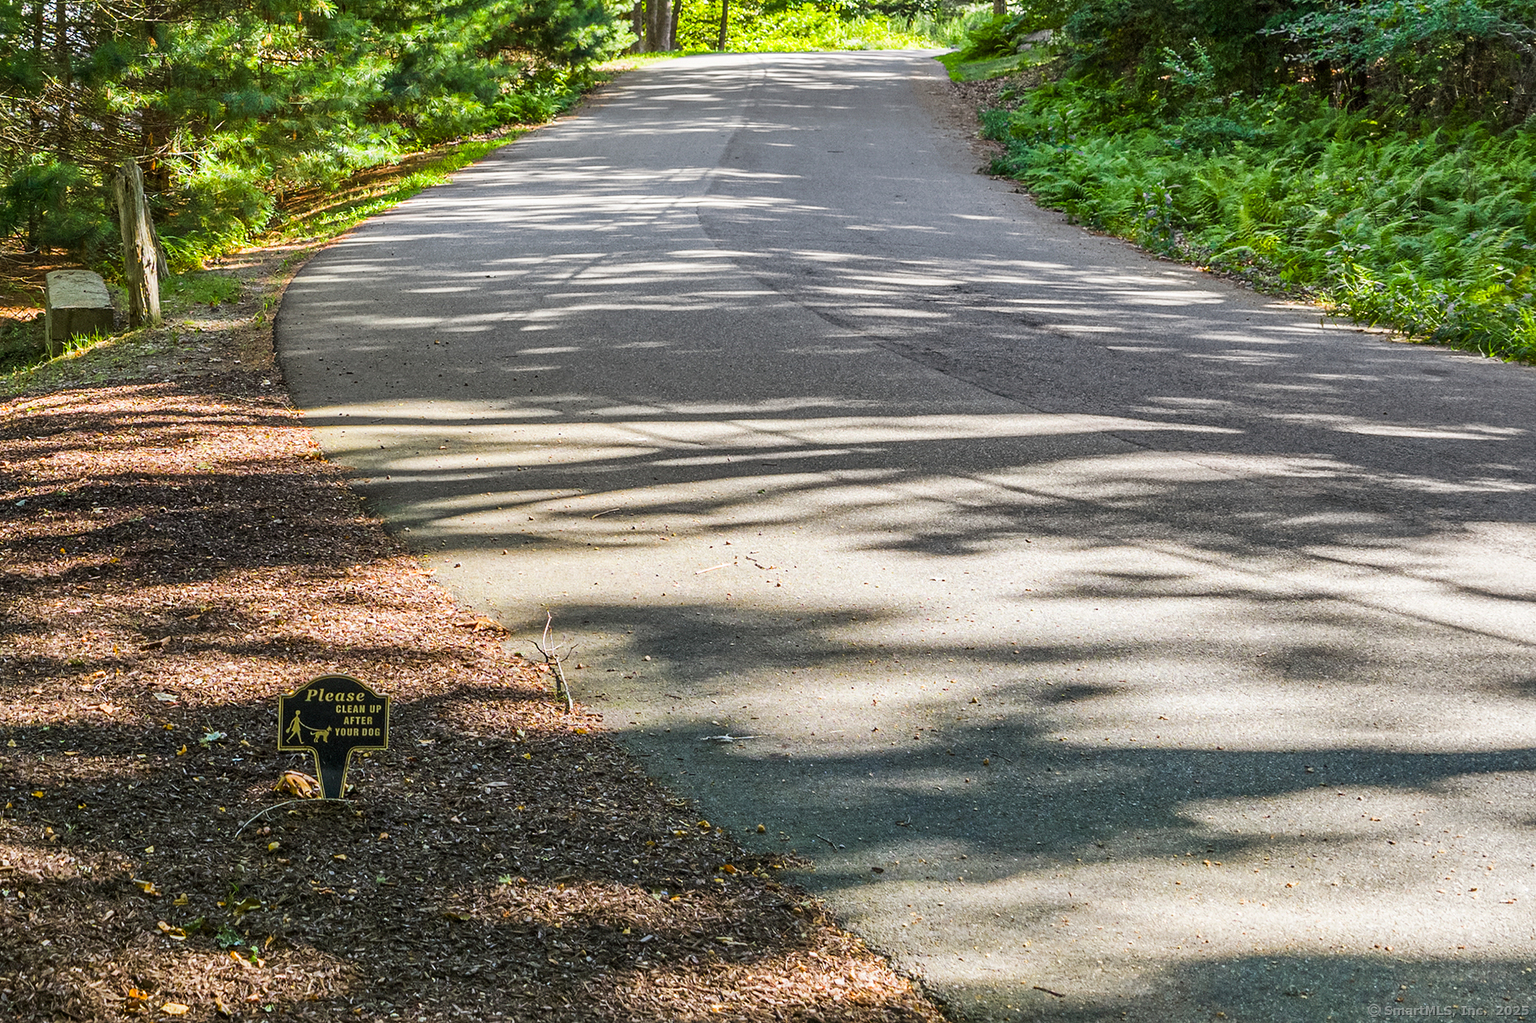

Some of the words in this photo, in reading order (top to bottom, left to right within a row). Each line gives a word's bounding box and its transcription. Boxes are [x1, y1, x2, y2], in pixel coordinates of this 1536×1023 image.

[304, 688, 365, 702] Please
[335, 704, 365, 714] CLEAN
[369, 704, 382, 714] UP
[343, 716, 373, 725] AFTER
[334, 728, 359, 737] YOUR
[361, 728, 381, 737] DOG
